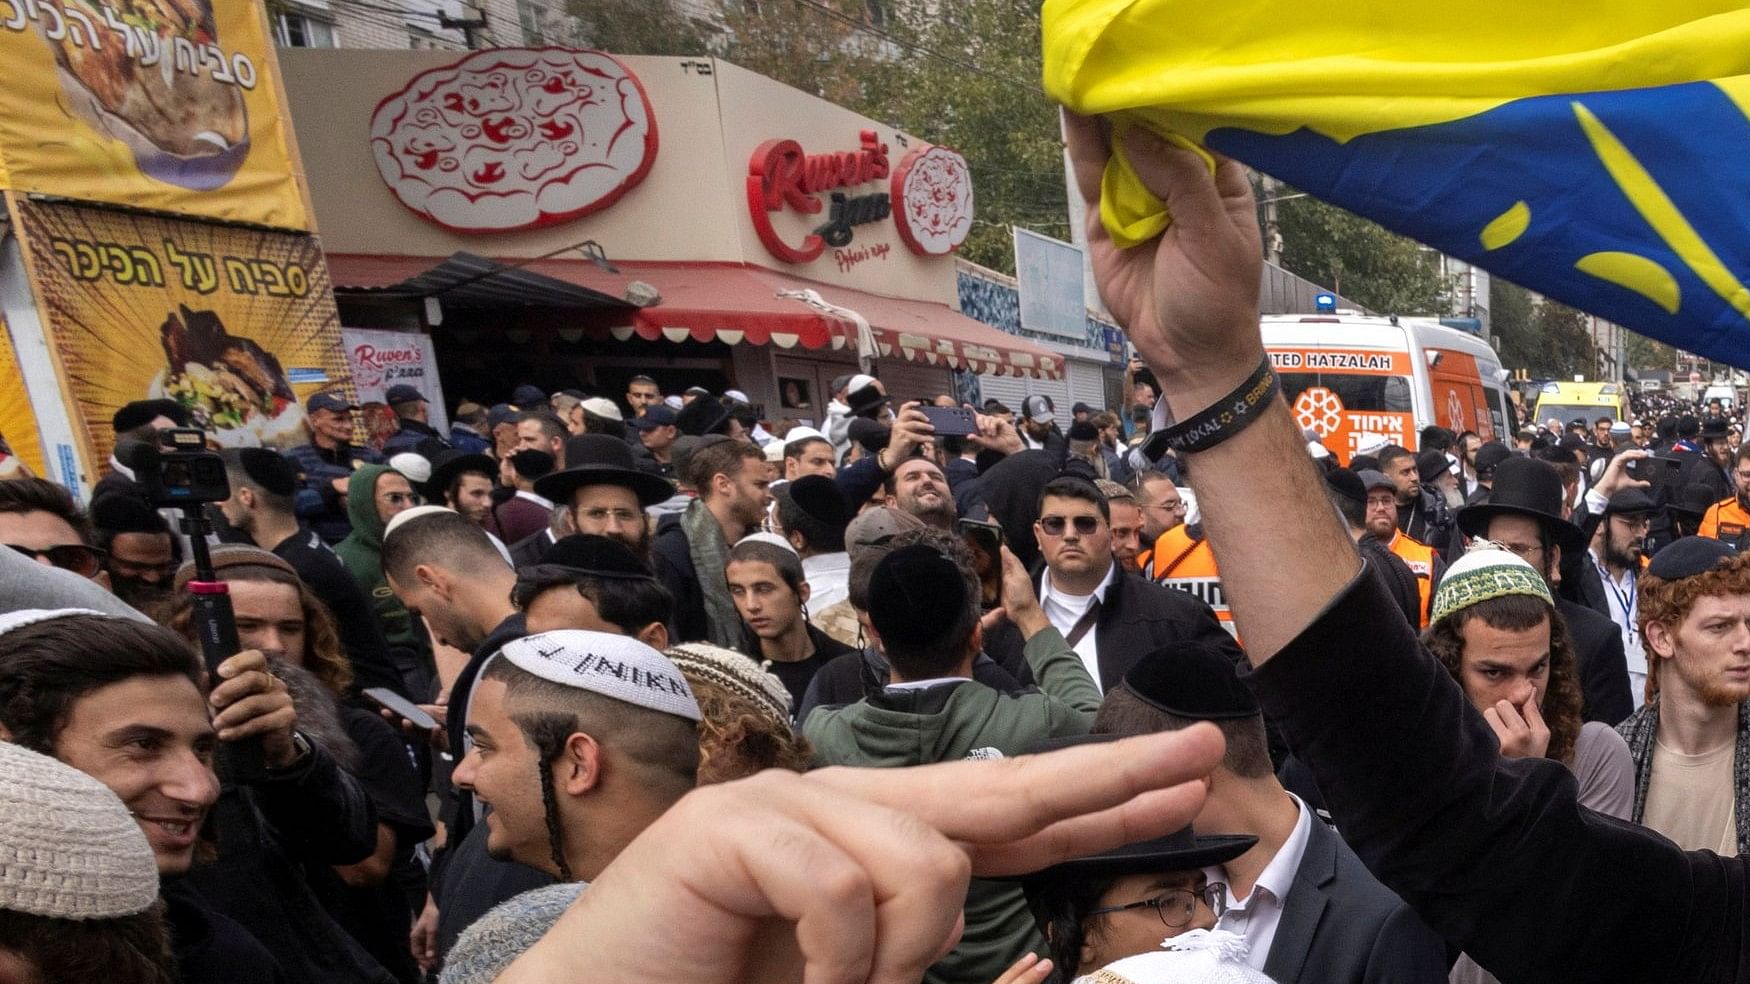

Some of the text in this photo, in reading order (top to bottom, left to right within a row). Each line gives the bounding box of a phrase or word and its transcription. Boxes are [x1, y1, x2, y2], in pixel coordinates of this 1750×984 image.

[0, 0, 257, 90] סביח על הכיכ
[50, 237, 309, 299] סביח על הכיכר
[354, 344, 423, 369] Ruven's
[1307, 354, 1391, 369] HATZALAH
[1186, 418, 1222, 445] LOCAL
[1245, 371, 1274, 406] BRING
[1347, 415, 1403, 431] איחוד
